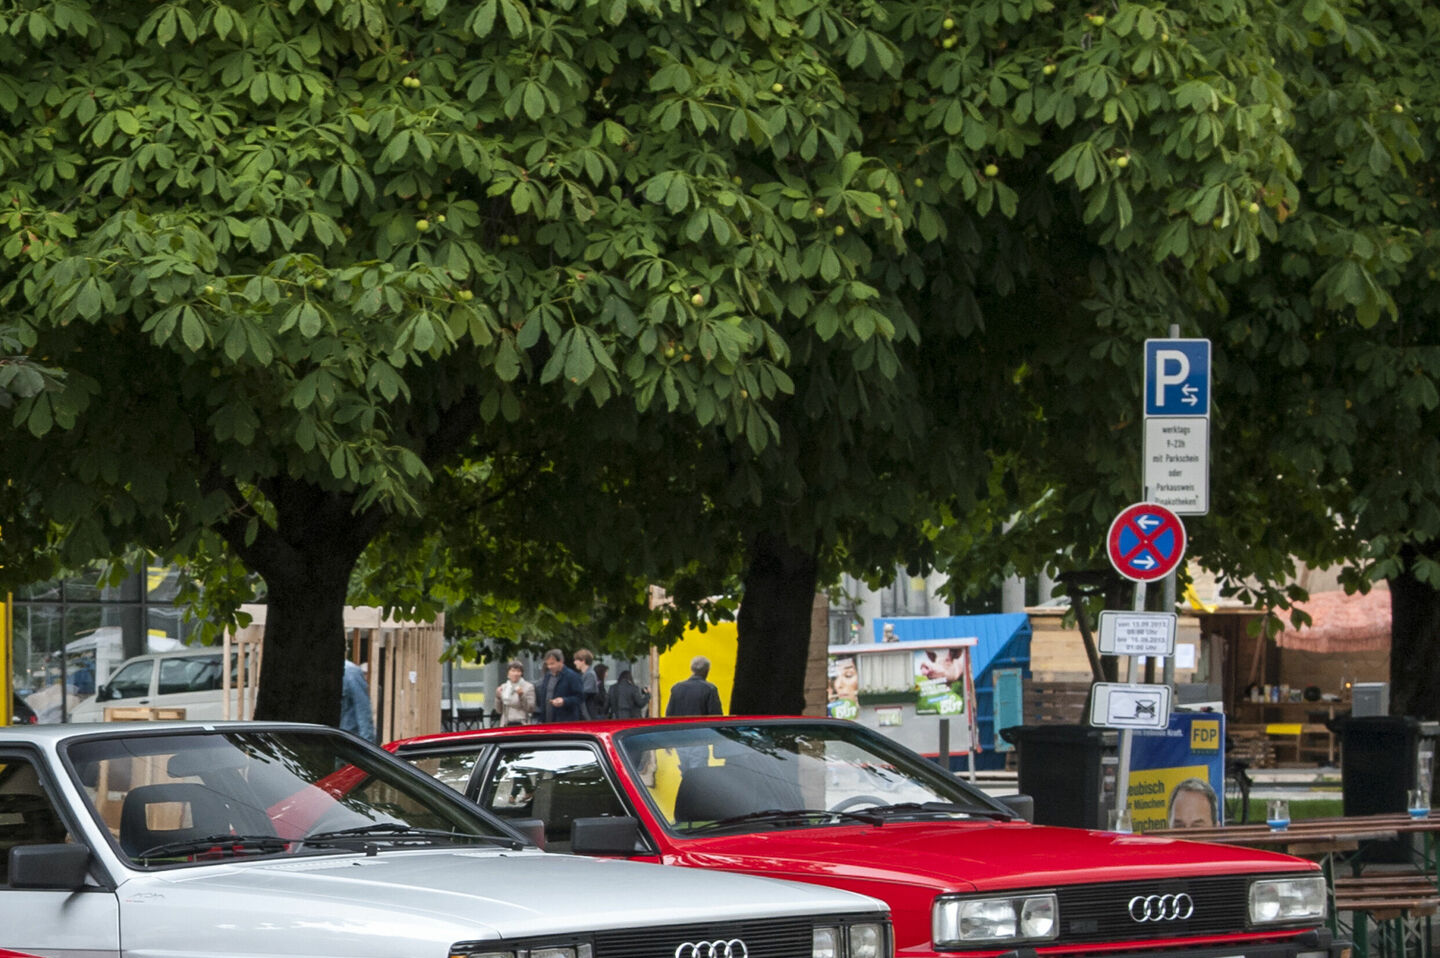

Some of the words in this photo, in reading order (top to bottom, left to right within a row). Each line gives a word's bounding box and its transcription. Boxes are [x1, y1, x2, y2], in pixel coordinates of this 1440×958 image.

[1155, 350, 1190, 407] P
[1162, 425, 1191, 437] werktags
[1152, 454, 1163, 463] mit
[1166, 454, 1199, 463] Parkschein
[1168, 469, 1182, 477] oder
[1156, 482, 1195, 491] Parkausweis
[1192, 728, 1217, 742] FDP
[1127, 780, 1165, 797] eubisch
